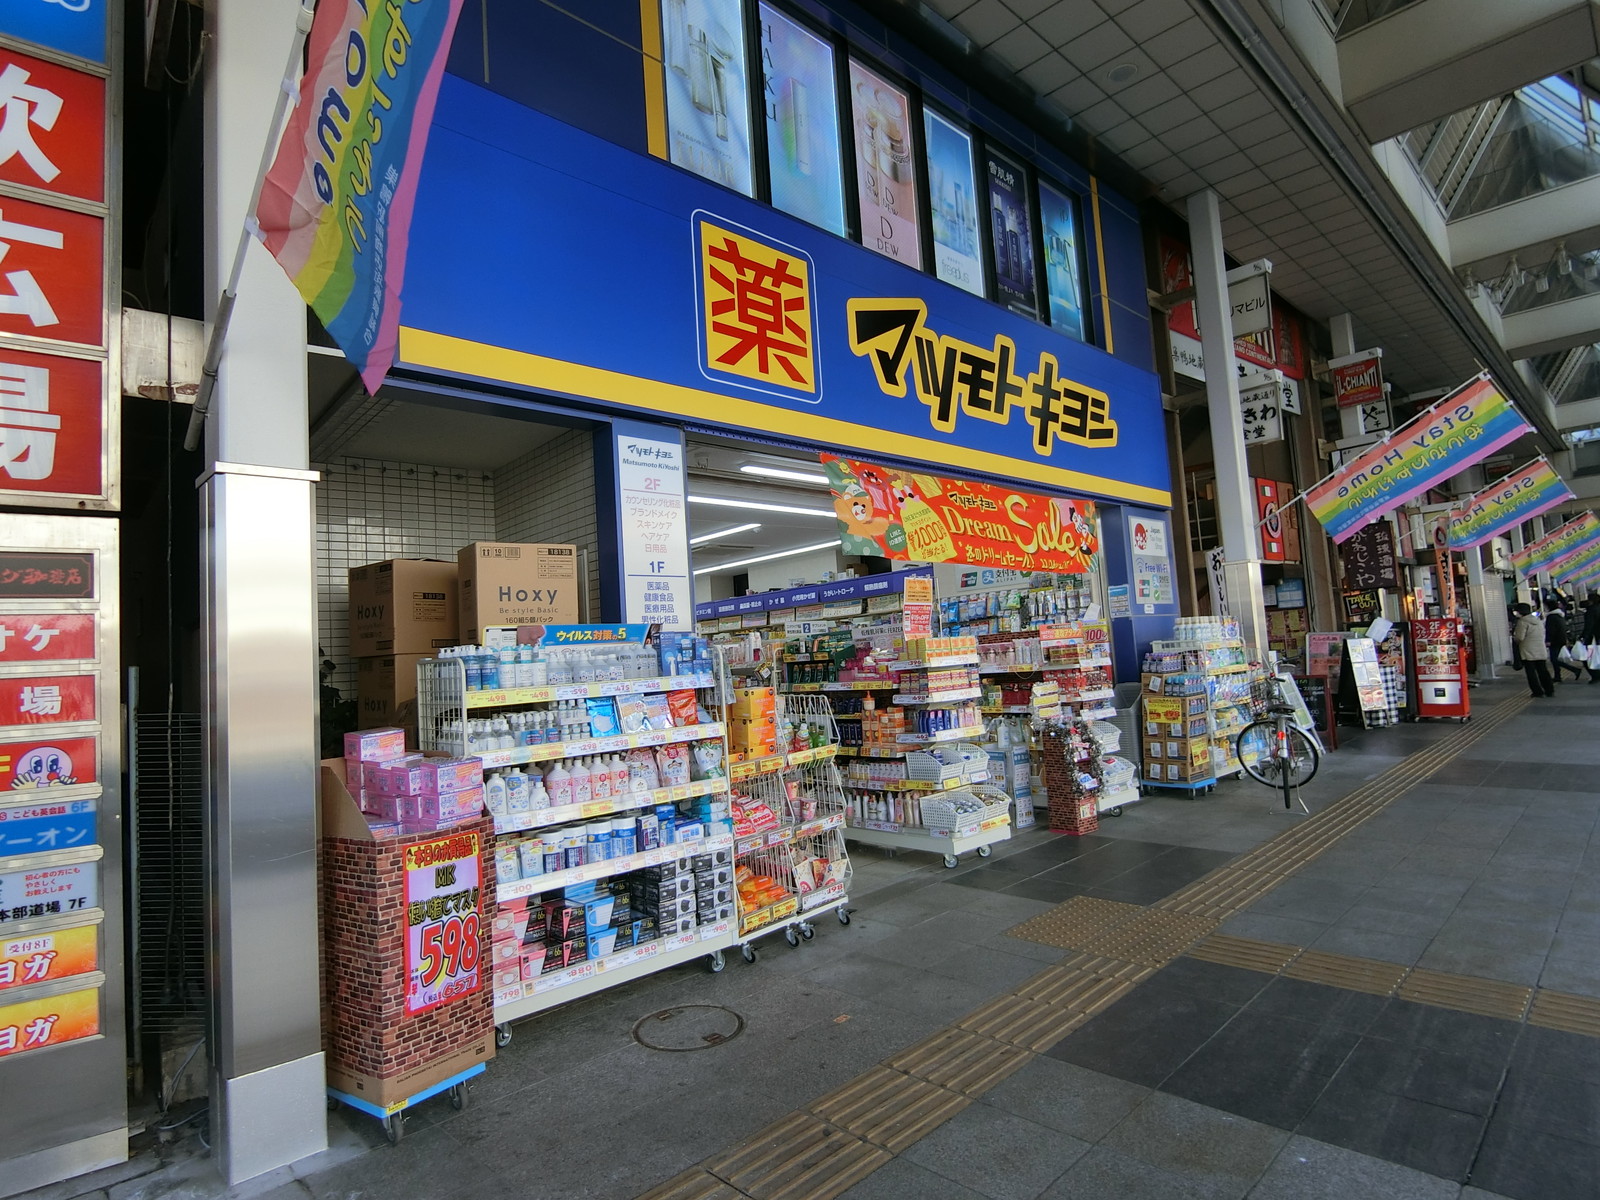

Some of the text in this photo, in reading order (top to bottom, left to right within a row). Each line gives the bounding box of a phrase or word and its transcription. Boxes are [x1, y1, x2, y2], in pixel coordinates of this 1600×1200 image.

[880, 215, 893, 240] D
[877, 237, 899, 257] DEW
[707, 236, 810, 386] 薬
[853, 305, 1116, 448] マツモトキヨシ
[627, 444, 674, 460] マツモトキヨシ
[622, 458, 657, 469] Matsumoto
[644, 478, 661, 491] 2F
[625, 496, 681, 509] カウンセリング化粧品
[949, 492, 997, 512] マツモトキヨシ
[630, 507, 678, 519] ブランドメイク
[637, 519, 673, 530] スキンケア
[940, 504, 1014, 543] Dream
[1003, 494, 1080, 557] Sale
[641, 532, 670, 542] ヘアケア
[645, 543, 667, 553] 日用品
[649, 561, 665, 573] 1F
[1144, 562, 1168, 574] Free Wi-Fi
[647, 581, 670, 591] 医薬品
[498, 586, 558, 605] Hoxy
[643, 592, 674, 602] 健康食品
[512, 606, 534, 615] style
[644, 603, 675, 614] 医療用品
[1359, 600, 1377, 609] OUT
[357, 605, 385, 620] Hoxy
[505, 616, 554, 624] 160組5個パック
[641, 615, 679, 625] 男性化粧品
[1429, 621, 1440, 629] 2F
[20, 685, 62, 715] 場
[489, 694, 506, 702] 498
[581, 742, 597, 750] 298
[71, 800, 90, 813] 6F
[413, 835, 473, 868] 本日のお買得品
[434, 863, 457, 888] MK
[25, 879, 56, 888] やさしく
[69, 897, 87, 909] 7F
[408, 886, 480, 927] 使い捨てマスク
[714, 923, 728, 932] 980
[680, 933, 694, 943] 980
[421, 912, 481, 987] 598
[637, 943, 657, 956] 880
[570, 964, 592, 977] 880
[502, 988, 520, 999] 798
